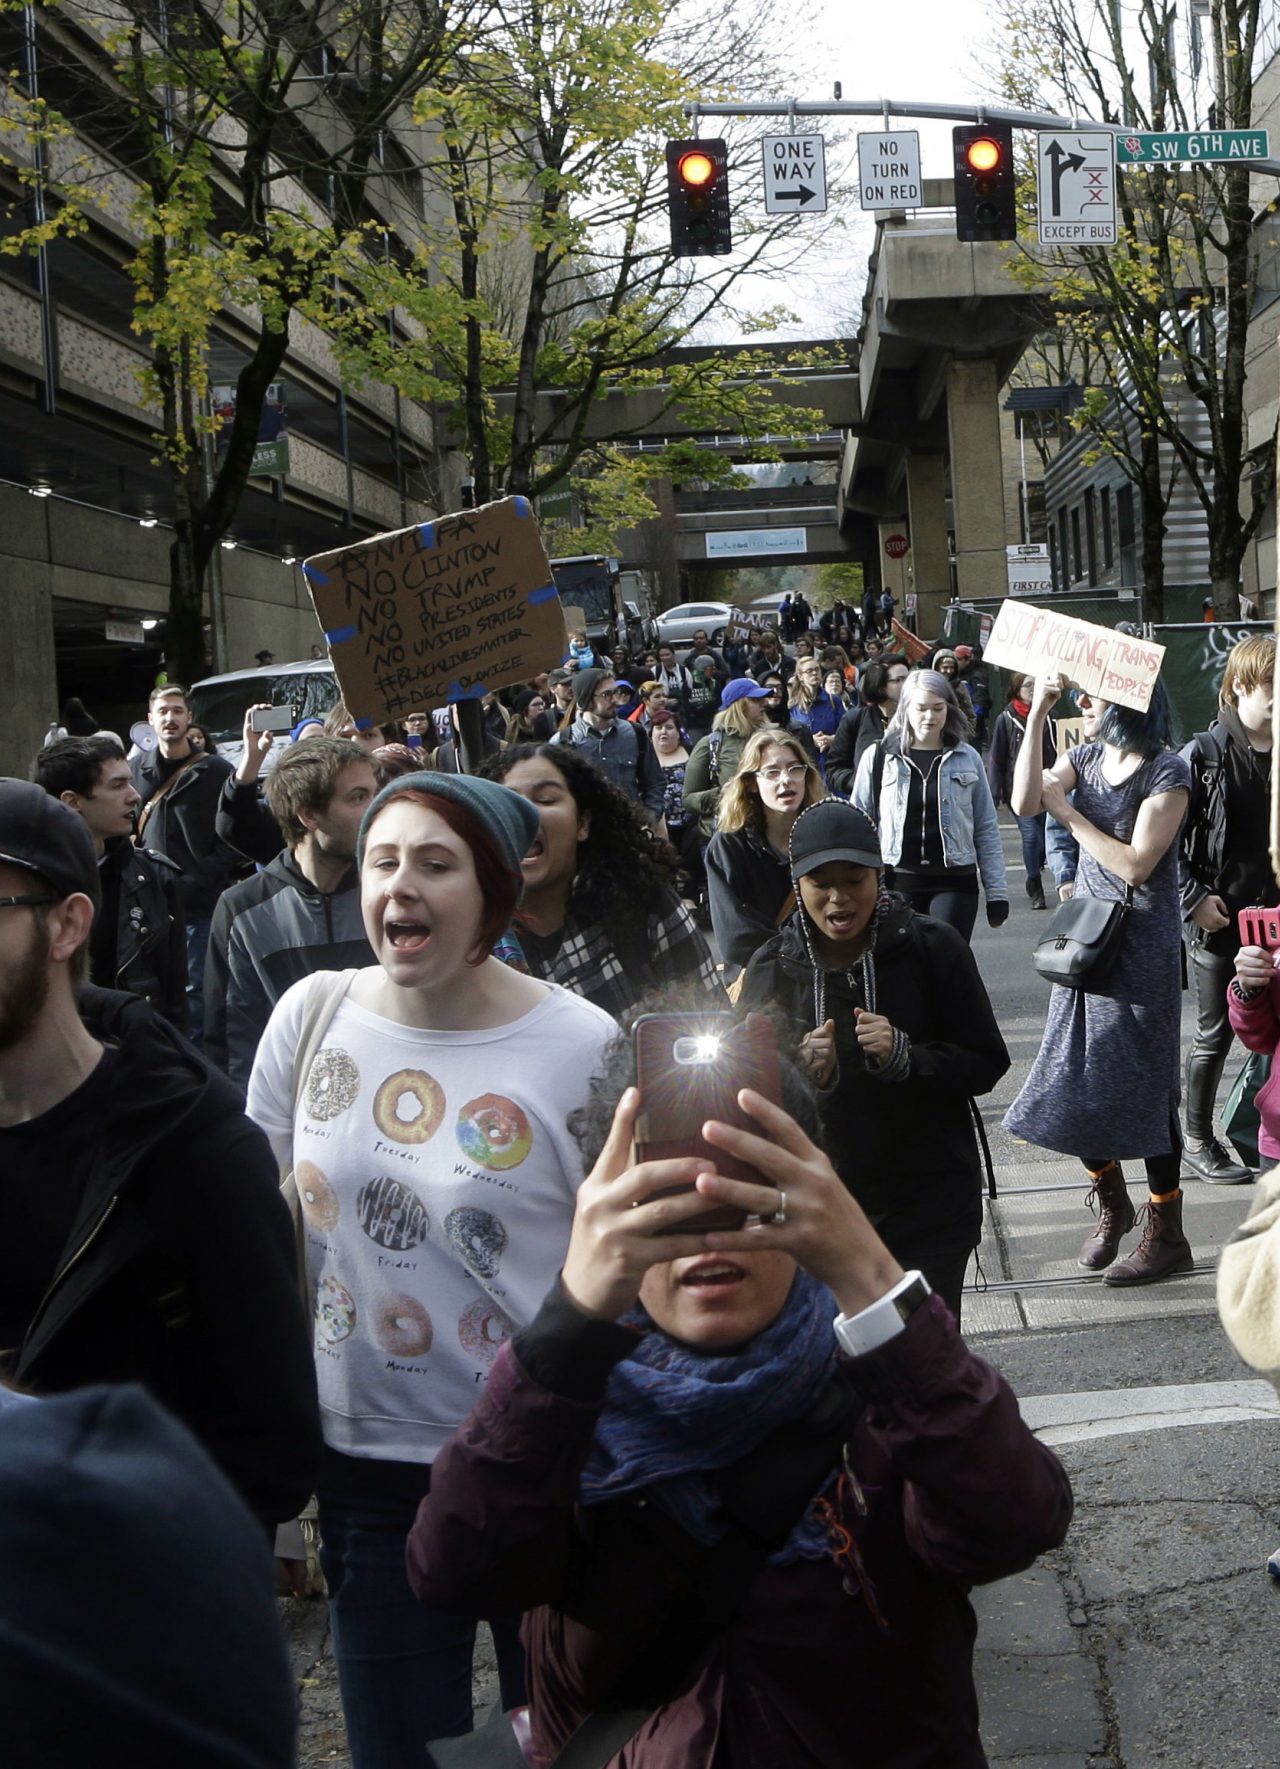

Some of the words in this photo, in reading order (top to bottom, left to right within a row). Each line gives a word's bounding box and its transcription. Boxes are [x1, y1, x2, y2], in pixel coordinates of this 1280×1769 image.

[774, 141, 814, 159] ONE
[879, 141, 898, 156] NO
[1151, 141, 1179, 160] SW
[1187, 134, 1224, 156] 6TH
[1228, 138, 1262, 157] AVE
[773, 161, 817, 180] WAY
[872, 163, 910, 178] TURN
[865, 186, 886, 201] ON
[890, 185, 919, 200] RED
[1044, 226, 1086, 239] EXCEPT
[1090, 225, 1112, 239] BUS
[886, 541, 907, 552] STOP
[346, 569, 396, 609] NO
[402, 536, 501, 590] CLINTON
[1013, 581, 1038, 591] FIRST
[357, 599, 397, 632] NO
[413, 566, 497, 614] TRUMP
[365, 624, 403, 655] NO
[418, 584, 517, 632] PRESIDENTS
[373, 646, 405, 673] NO
[413, 625, 470, 657] UNITED
[477, 602, 526, 632] STATES
[996, 608, 1046, 650] STOP
[1112, 640, 1159, 672] TRANS
[374, 1141, 421, 1164] Tuesday
[453, 1163, 520, 1193] Wednesday
[377, 1256, 418, 1271] Friday
[386, 1360, 428, 1375] Monday
